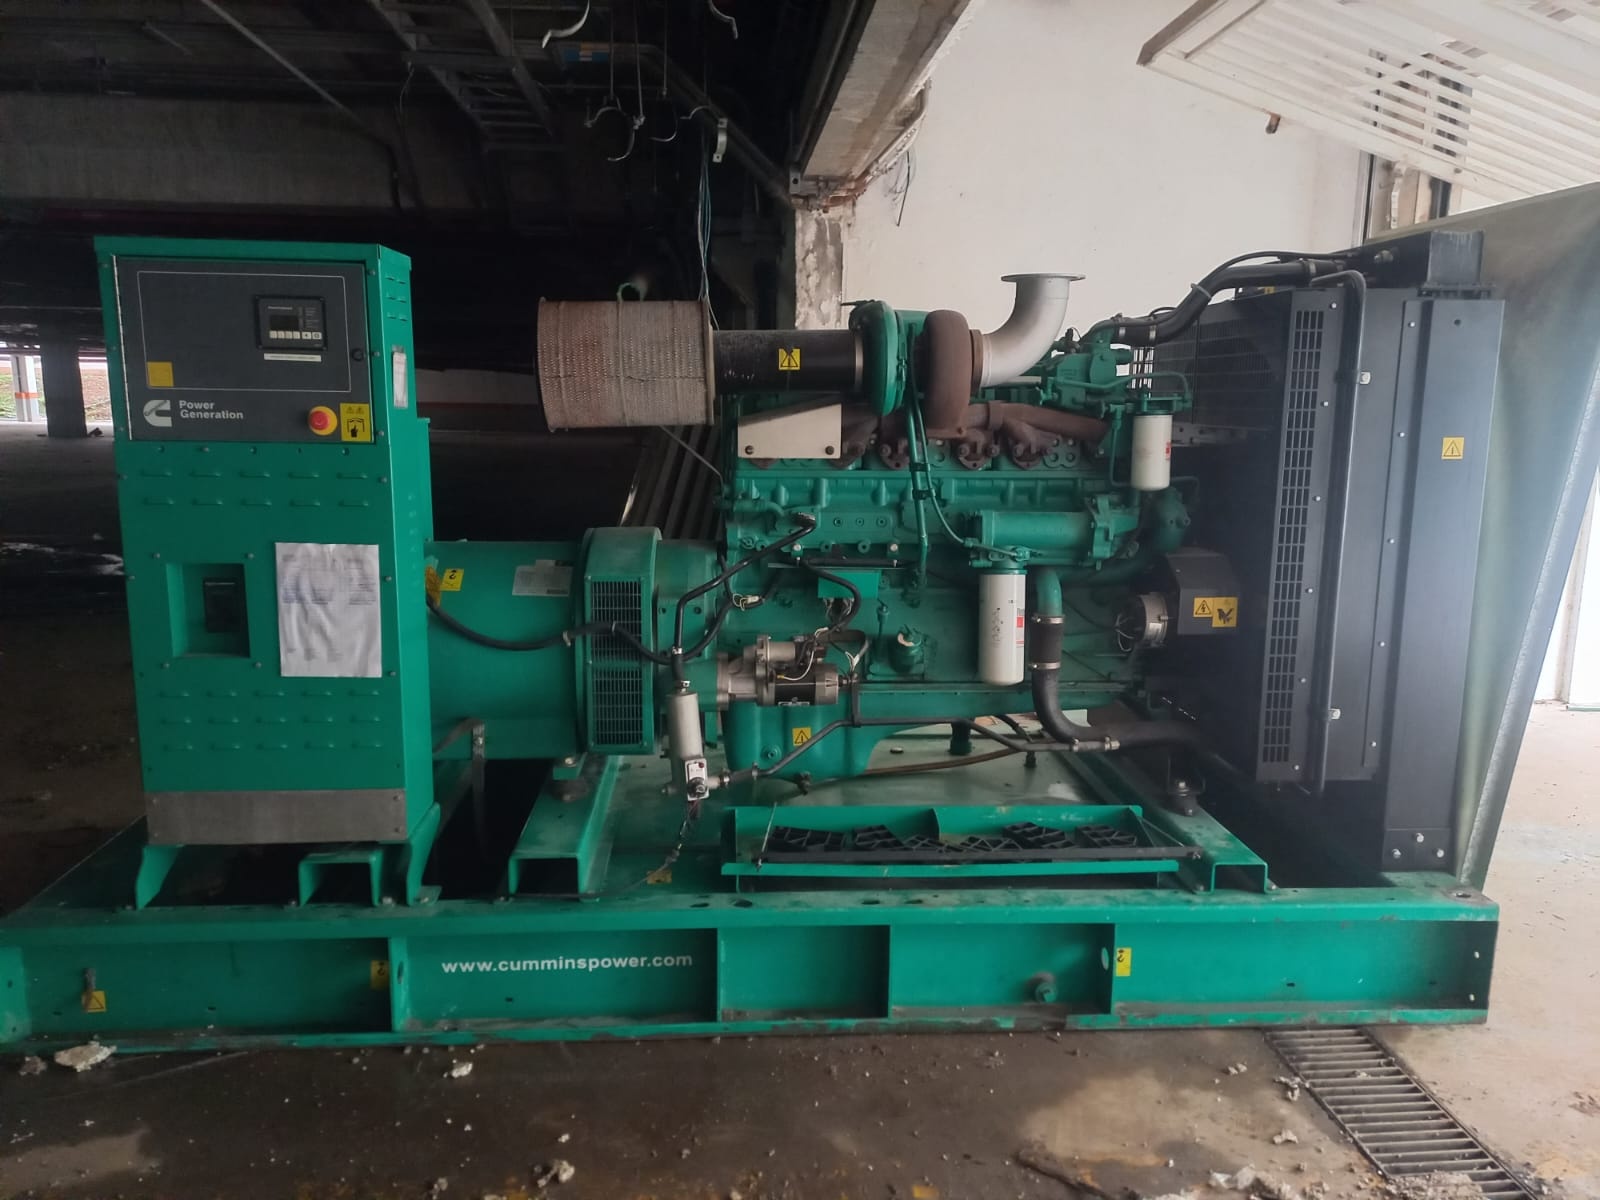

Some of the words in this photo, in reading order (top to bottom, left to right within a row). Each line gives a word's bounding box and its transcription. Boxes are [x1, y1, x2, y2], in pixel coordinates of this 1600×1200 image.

[179, 400, 215, 410] Power
[180, 410, 244, 419] Generation
[441, 955, 693, 973] www.cumminspower.com
